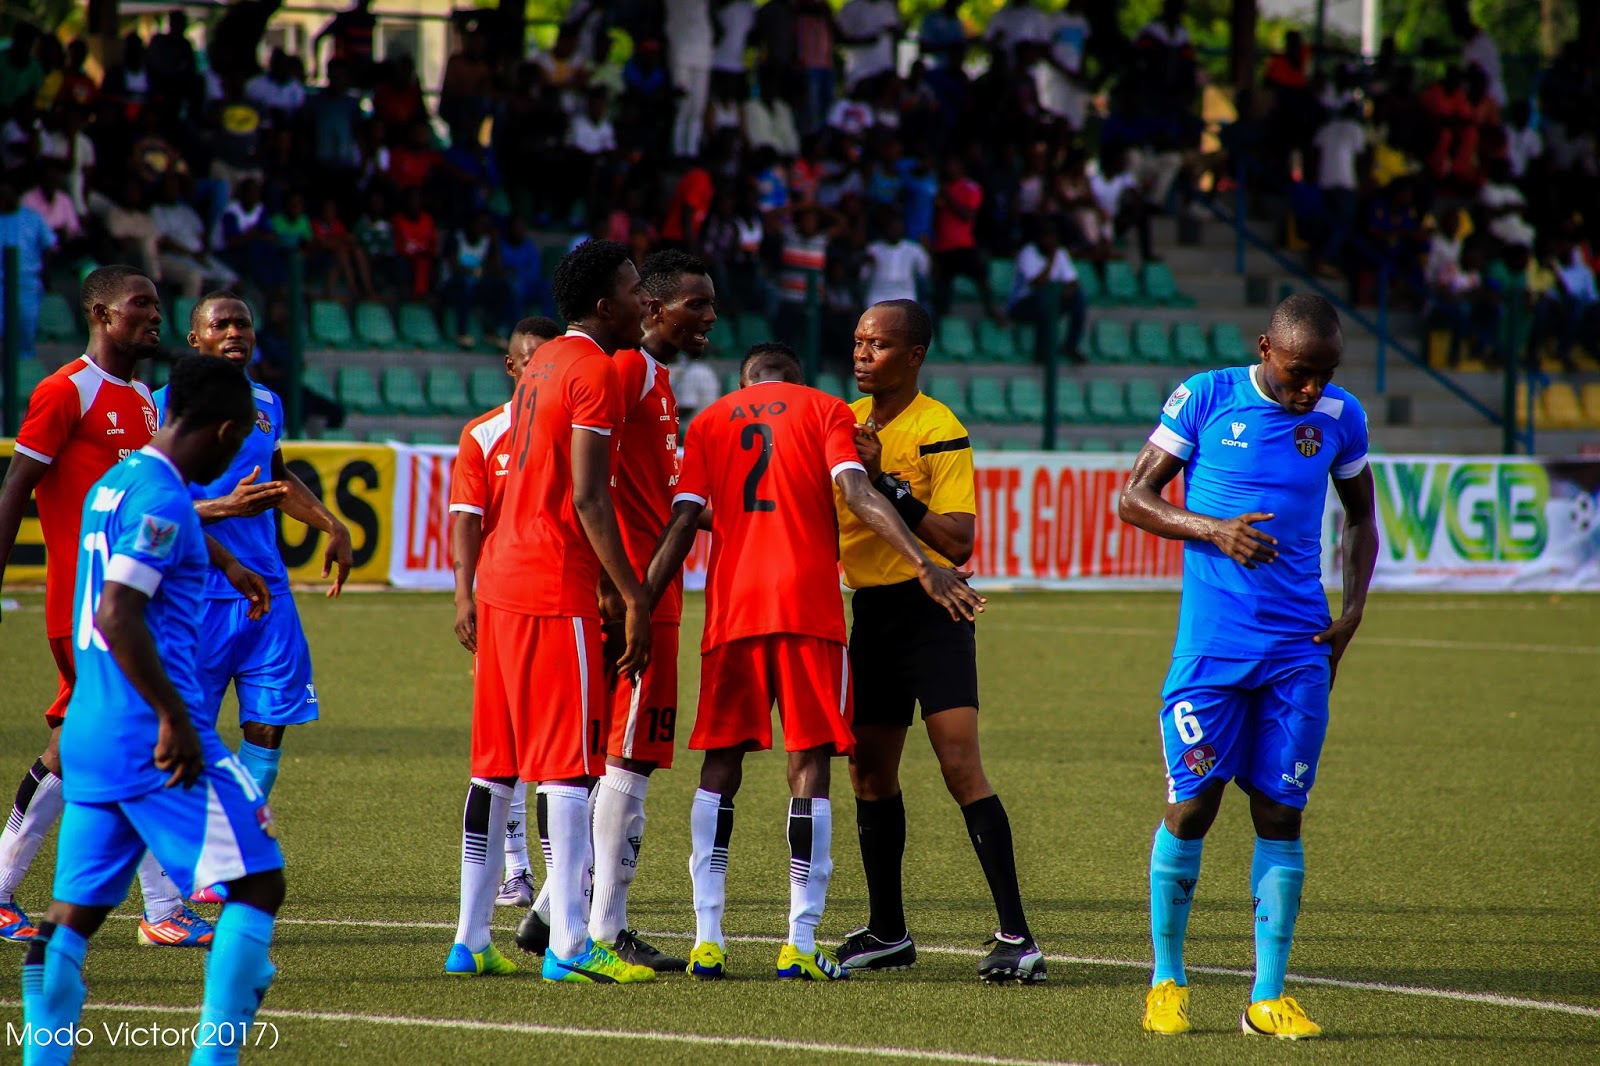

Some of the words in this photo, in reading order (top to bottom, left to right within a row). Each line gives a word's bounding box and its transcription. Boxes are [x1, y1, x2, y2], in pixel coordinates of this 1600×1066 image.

[729, 400, 787, 422] AYO
[741, 423, 776, 512] 2
[964, 467, 1022, 577] ATE
[1371, 461, 1550, 563] WGB
[647, 707, 676, 744] 19
[1173, 700, 1204, 745] 6
